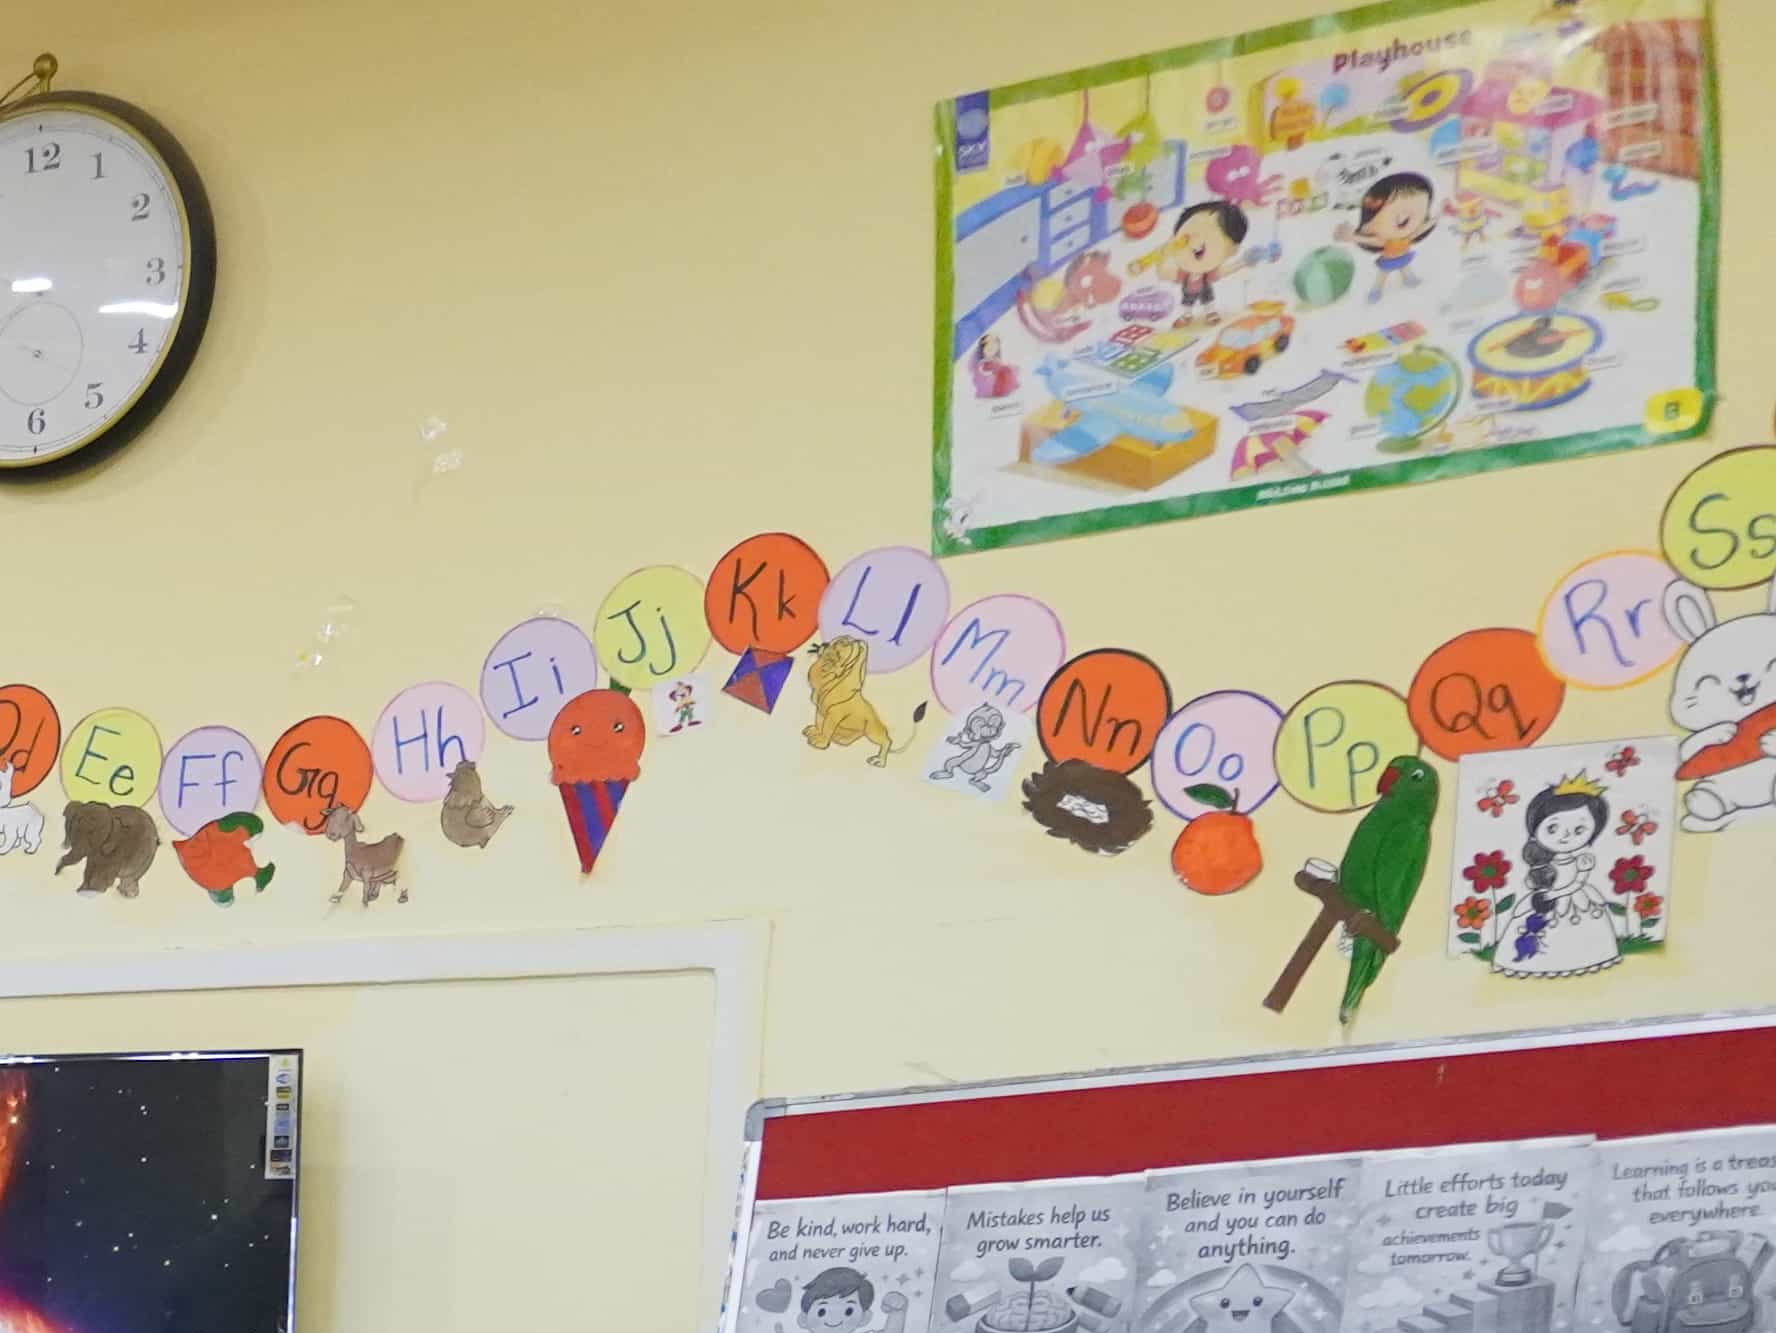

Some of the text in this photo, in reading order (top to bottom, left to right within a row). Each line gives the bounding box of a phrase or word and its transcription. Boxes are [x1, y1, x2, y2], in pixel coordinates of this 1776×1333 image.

[1332, 29, 1472, 75] Playhouse
[23, 142, 62, 175] 12
[90, 152, 108, 180] 1
[130, 192, 151, 222] 2
[145, 256, 166, 286] 3
[127, 327, 148, 355] 4
[83, 381, 105, 410] 5
[26, 407, 47, 436] 6
[74, 724, 135, 796] Ee
[177, 750, 245, 808] Ff
[275, 741, 340, 832] Gg
[392, 704, 468, 776] Hh
[492, 651, 564, 720] Ii
[607, 599, 678, 677] Jj
[726, 557, 797, 641] Kk
[940, 617, 1026, 707] Mm
[1050, 677, 1143, 757] Nn
[1173, 721, 1245, 783] Oo
[1302, 705, 1380, 807] Pp
[1429, 672, 1538, 741] Qq
[1563, 577, 1654, 669] Rr
[1688, 493, 1776, 570] Ss
[1385, 1168, 1568, 1198] Little efforts today
[1612, 1160, 1689, 1180] Learning
[1695, 1158, 1706, 1173] is
[1713, 1159, 1722, 1171] a
[1166, 1177, 1347, 1212] Believe in yourself
[1633, 1181, 1671, 1203] that
[1678, 1178, 1739, 1198] follows
[966, 1203, 1111, 1230] Mistakes help us
[1184, 1206, 1327, 1236] and you can do
[1415, 1194, 1519, 1219] create big
[767, 1220, 791, 1240] Be
[842, 1215, 881, 1234] work
[887, 1211, 931, 1236] hard,
[1382, 1227, 1481, 1246] achievements
[769, 1243, 908, 1263] and never give up.
[976, 1232, 1102, 1258] grow smarter.
[1198, 1234, 1296, 1264] anything.
